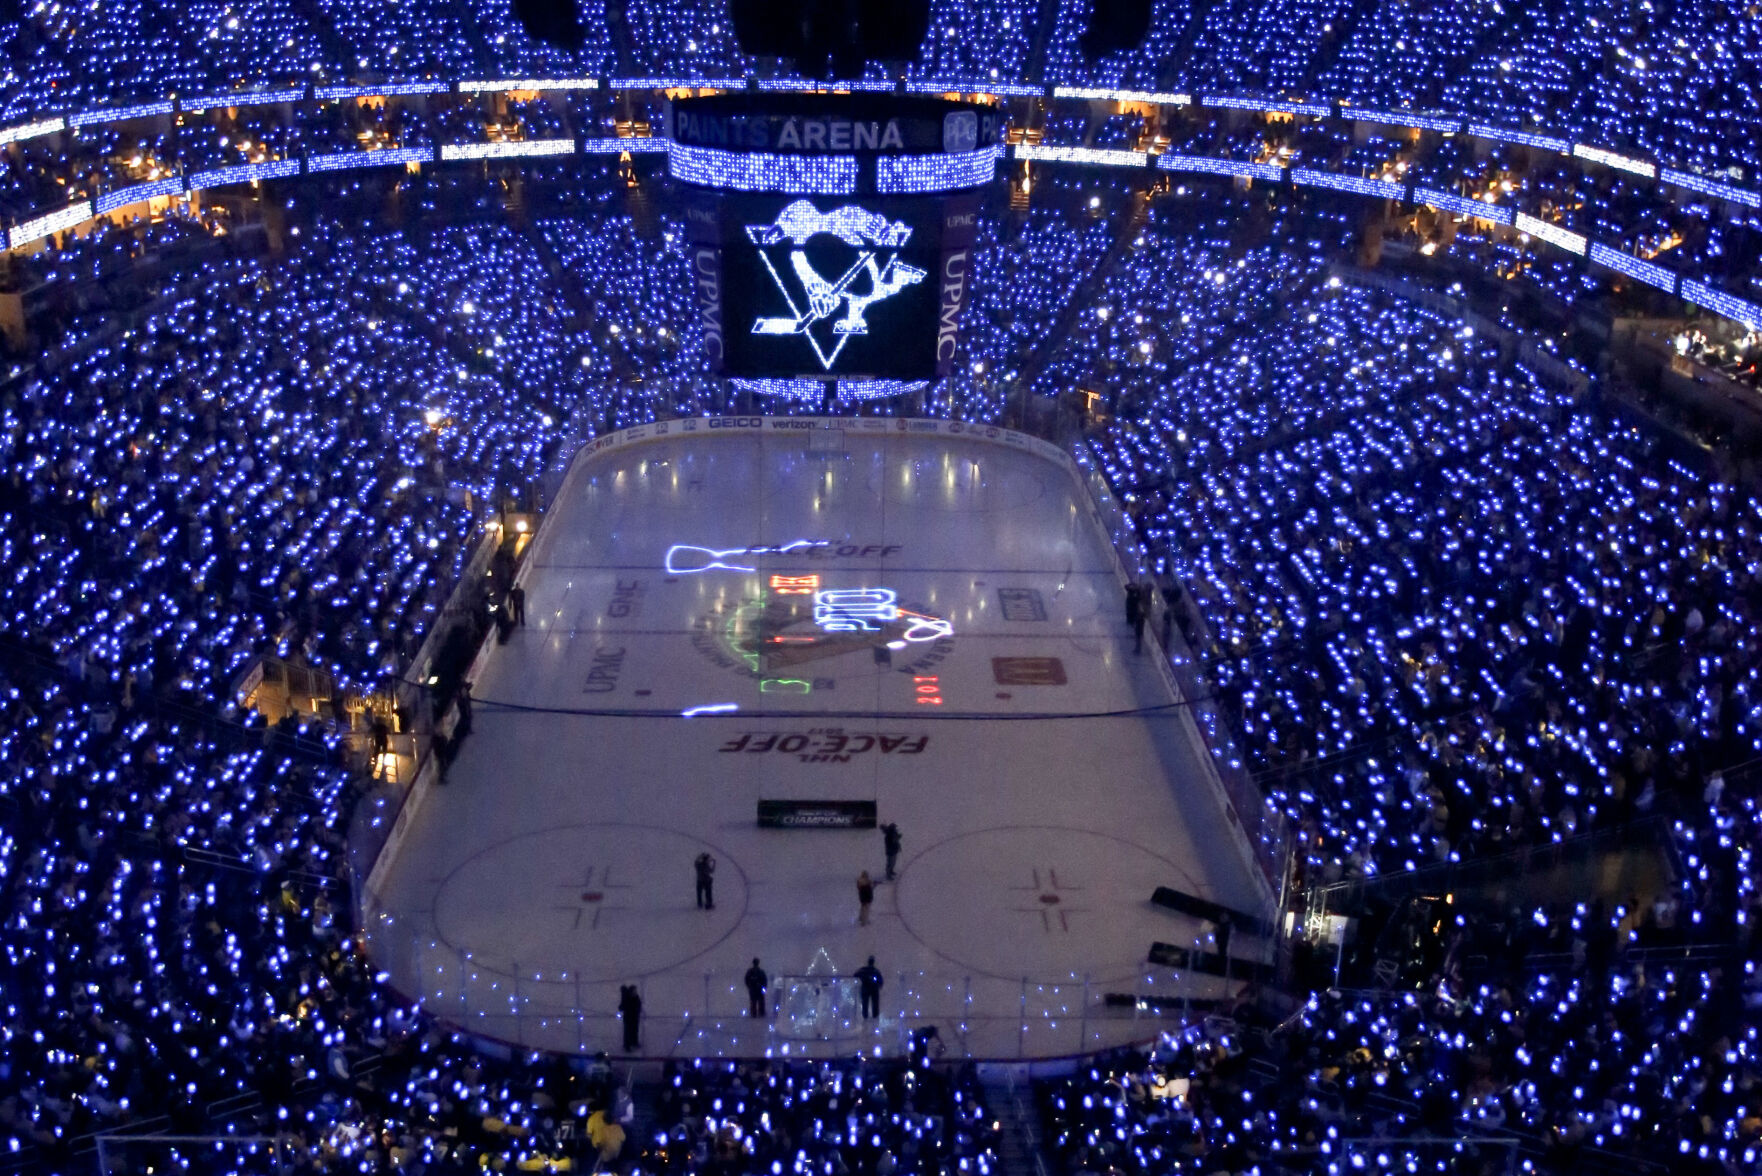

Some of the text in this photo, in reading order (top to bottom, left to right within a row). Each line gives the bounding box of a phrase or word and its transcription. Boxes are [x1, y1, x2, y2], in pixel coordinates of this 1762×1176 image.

[677, 110, 769, 146] PAINTS
[777, 121, 904, 150] ARENA
[695, 251, 723, 359] UPMC
[937, 253, 966, 361] UPMC
[708, 417, 762, 429] GEICO
[772, 419, 816, 430] verizon
[581, 645, 627, 695] UPMC
[717, 734, 930, 754] FACE-OFF
[799, 754, 851, 763] NHL
[782, 815, 851, 824] CHAMPIONS
